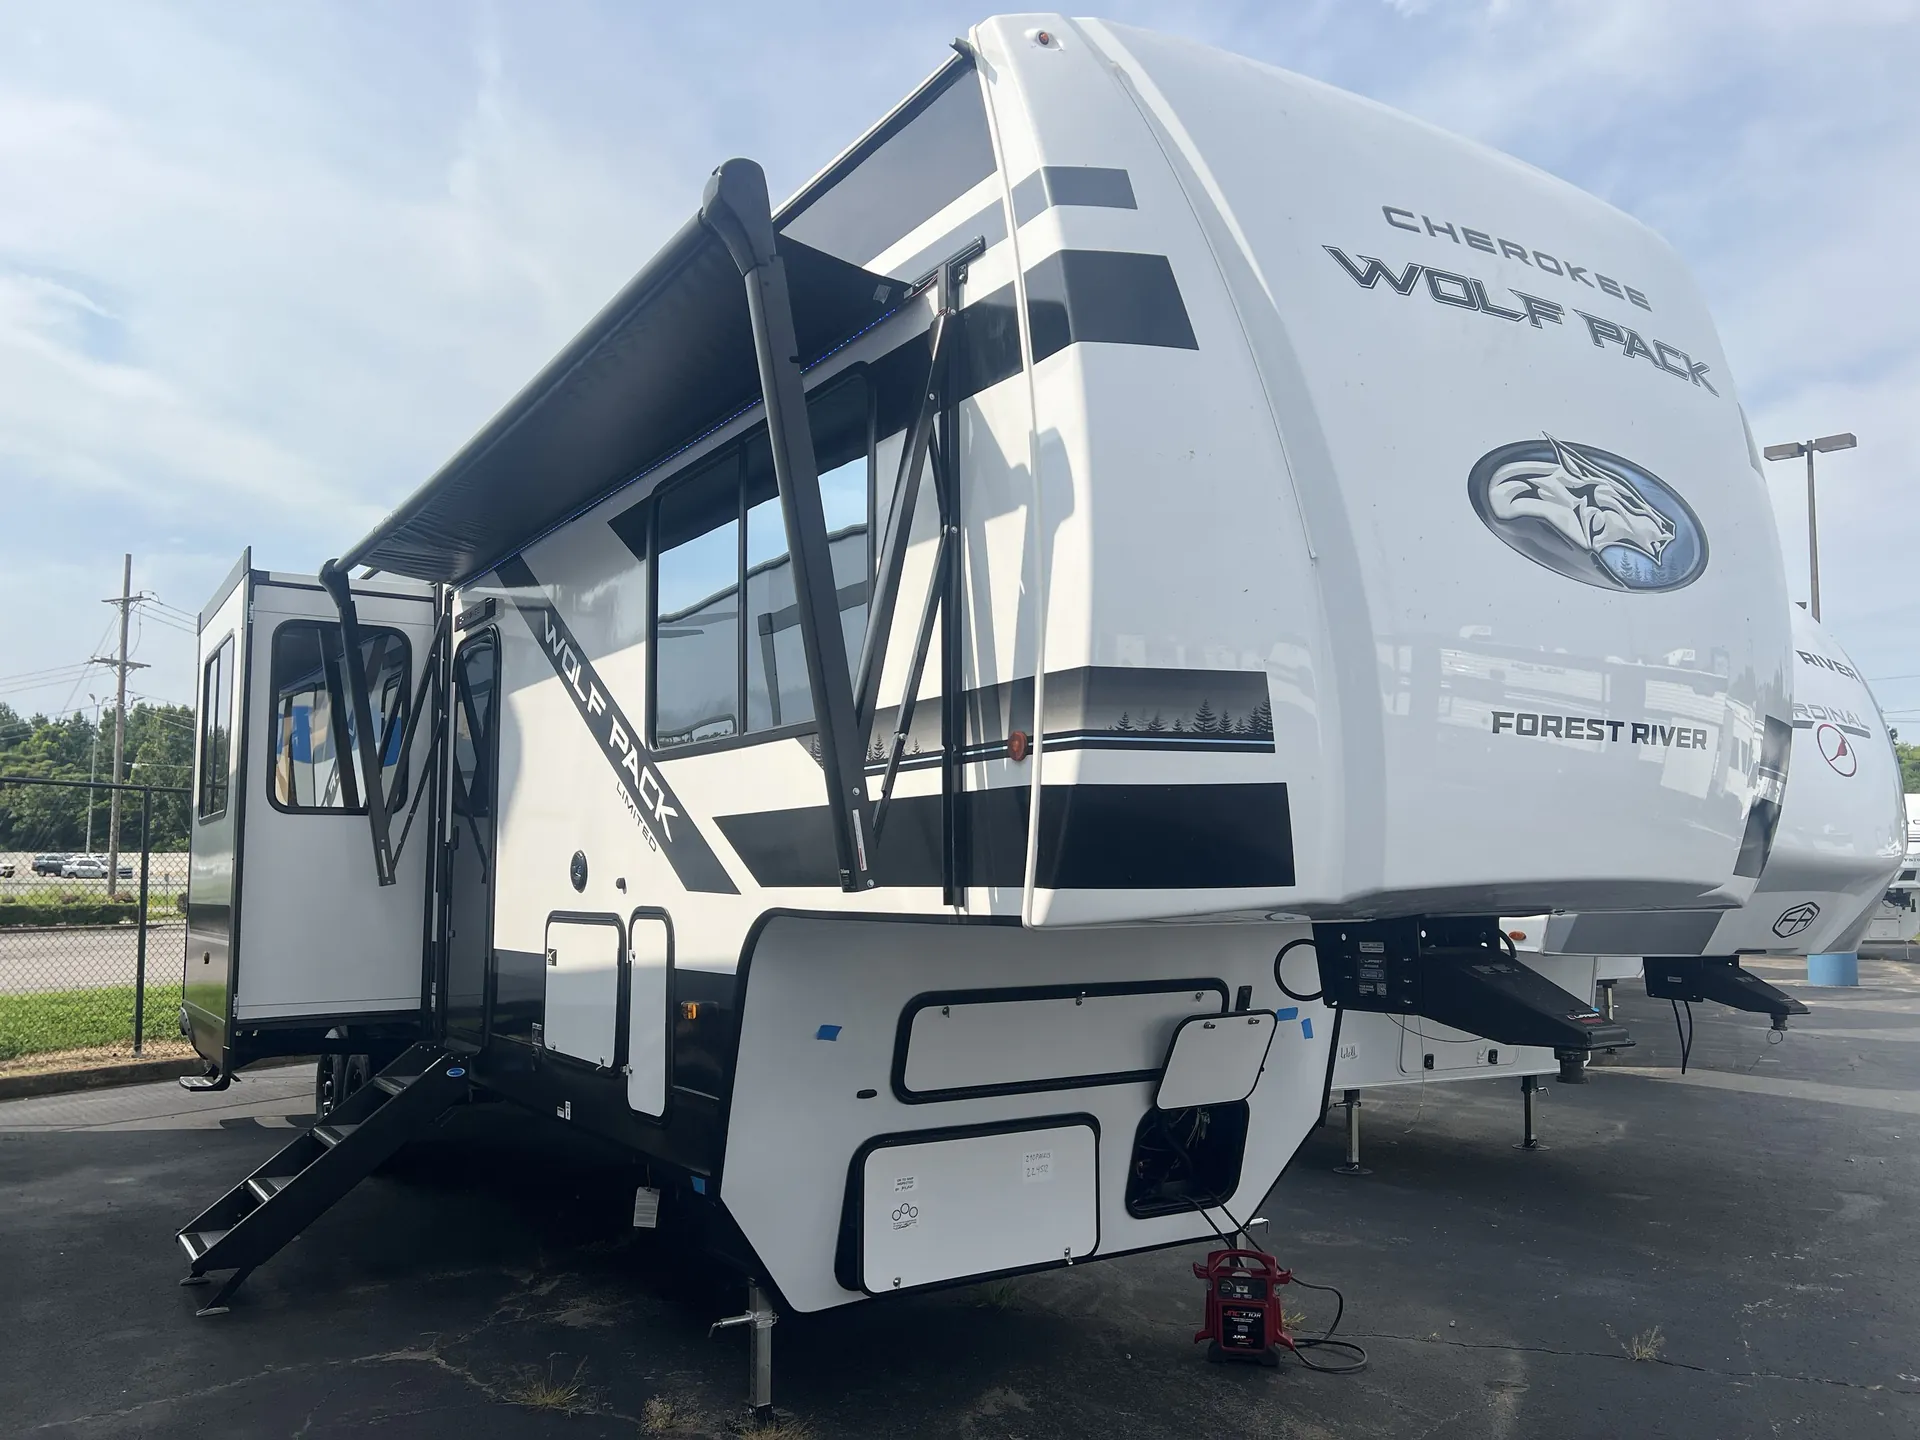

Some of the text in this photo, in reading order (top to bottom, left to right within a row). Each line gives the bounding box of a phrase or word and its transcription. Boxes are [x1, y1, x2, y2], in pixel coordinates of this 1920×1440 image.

[1382, 205, 1653, 313] CHEROKEE
[1321, 244, 1720, 397] WOLF PACK
[1795, 649, 1861, 683] RIVER
[544, 610, 679, 843] WOLF PACK
[1491, 710, 1708, 750] FOREST RIVER
[1793, 702, 1871, 730] RDINAL
[616, 781, 657, 852] LIMITED
